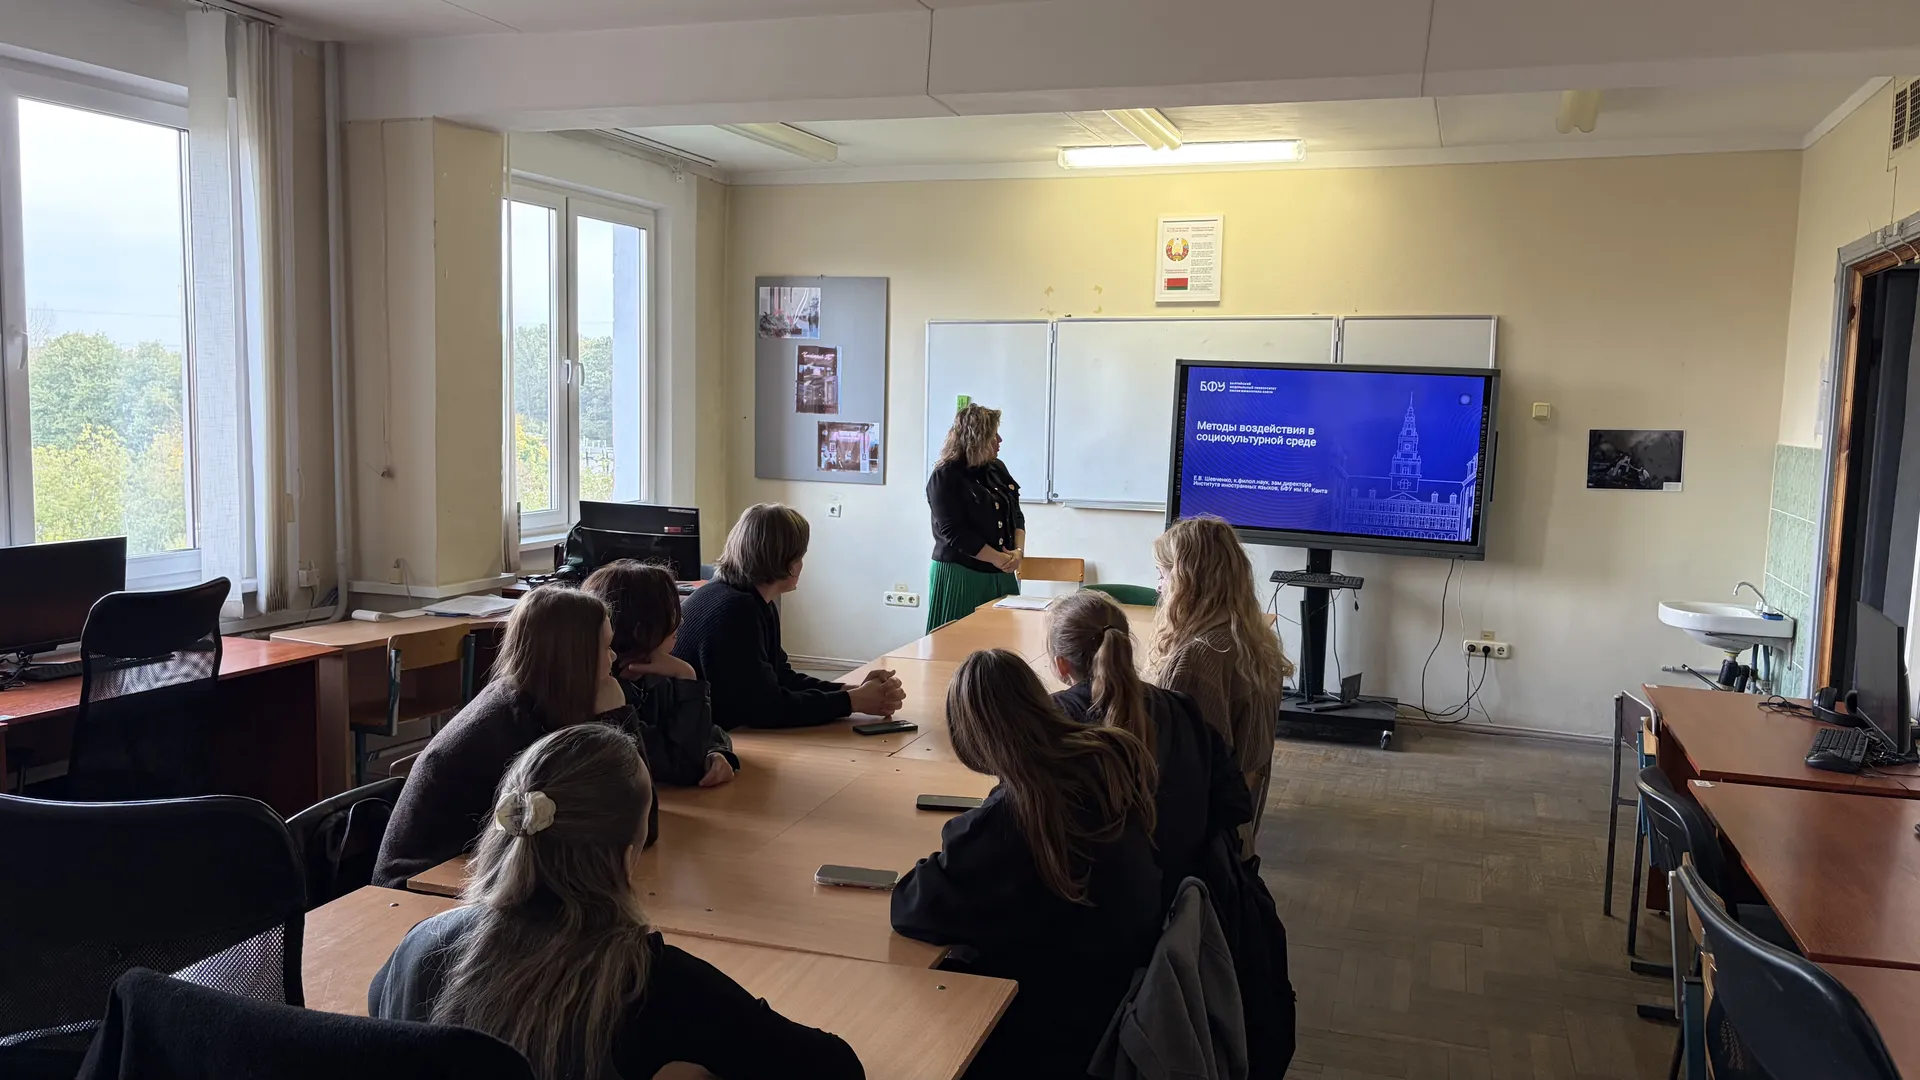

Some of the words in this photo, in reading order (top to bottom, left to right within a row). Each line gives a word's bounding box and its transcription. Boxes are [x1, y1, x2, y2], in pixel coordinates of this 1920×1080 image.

[1200, 381, 1226, 392] БФУ
[1197, 421, 1237, 432] Методы
[1240, 424, 1306, 435] воздействия
[1308, 427, 1315, 436] в
[1196, 433, 1283, 446] социокультурной
[1286, 437, 1317, 447] среде
[1221, 482, 1257, 490] иностранных
[1257, 484, 1280, 492] языков,
